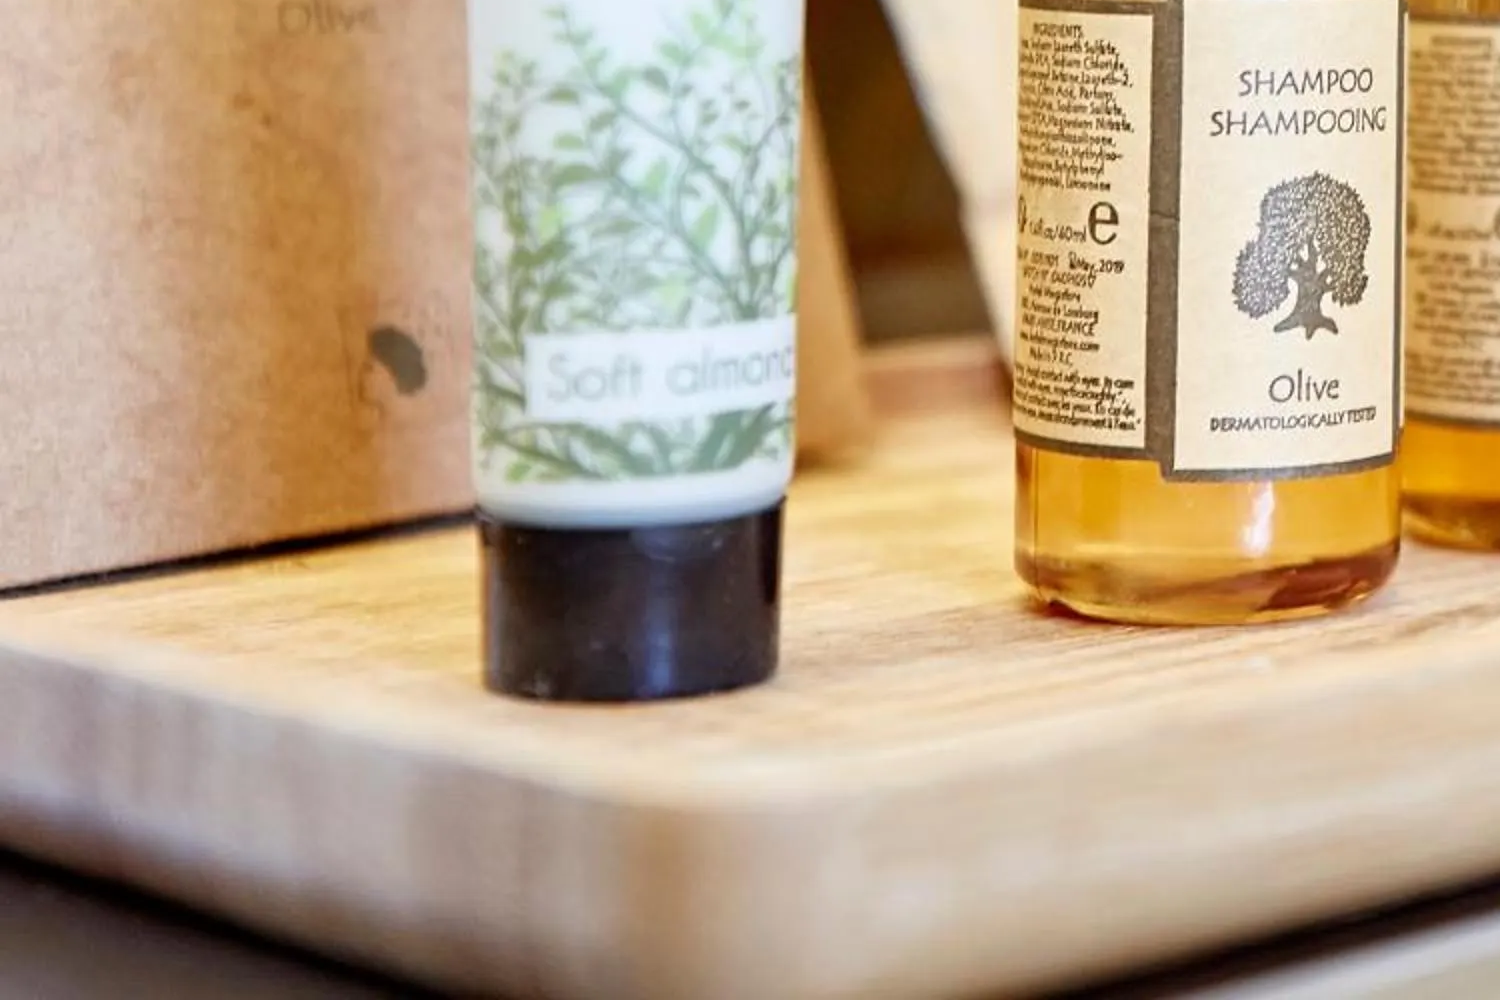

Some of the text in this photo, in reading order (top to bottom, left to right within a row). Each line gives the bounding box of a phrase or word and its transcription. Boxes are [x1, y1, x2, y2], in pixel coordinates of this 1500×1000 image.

[1238, 67, 1374, 97] SHAMPOO
[1210, 106, 1387, 137] SHAMPOOING
[1088, 201, 1120, 246] e
[547, 350, 644, 402] Soft
[1268, 367, 1340, 403] Olive
[1209, 408, 1345, 432] DERMATOLOGICALLY
